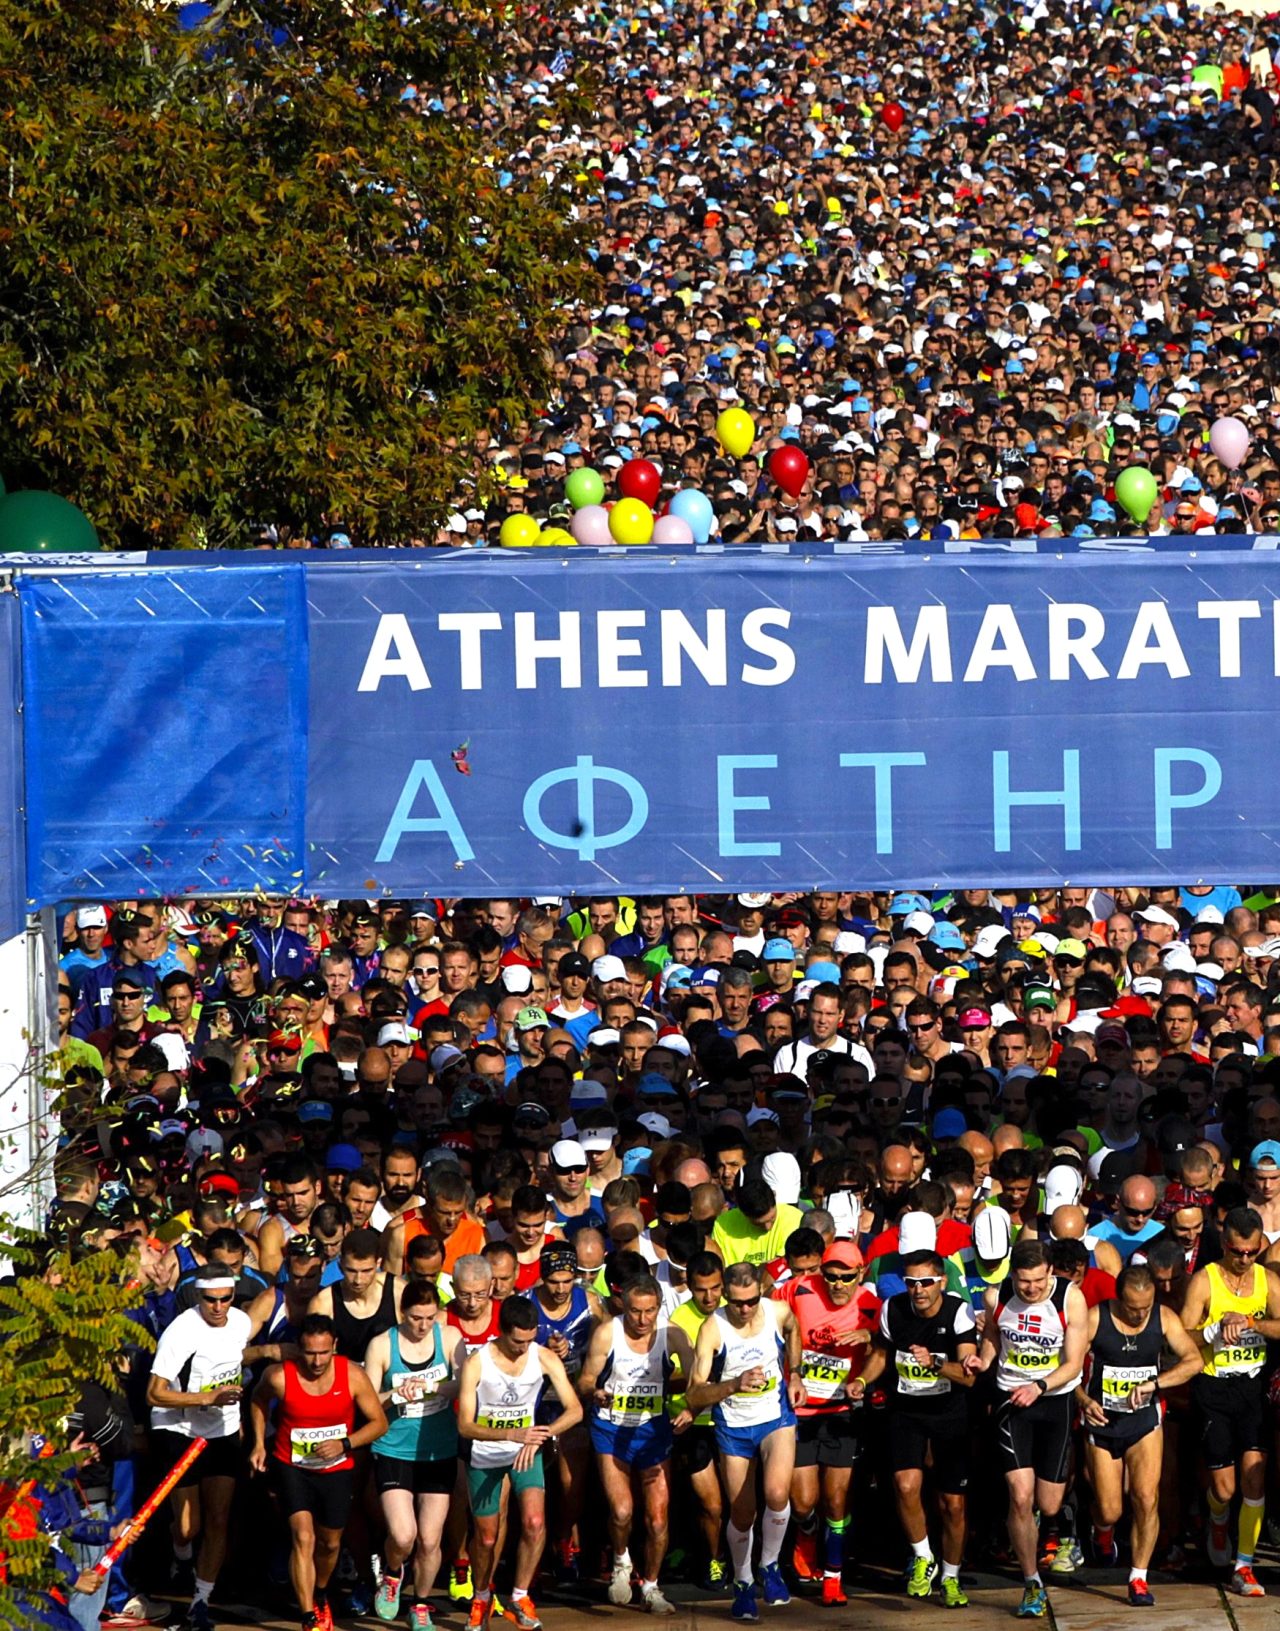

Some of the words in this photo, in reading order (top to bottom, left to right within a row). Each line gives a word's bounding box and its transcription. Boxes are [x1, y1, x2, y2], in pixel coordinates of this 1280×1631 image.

[357, 606, 796, 692] ATHENS
[1003, 1329, 1059, 1346] NORWAY
[1013, 1354, 1051, 1366] 1090
[616, 1395, 655, 1410] 1854
[487, 1417, 524, 1430] 1853
